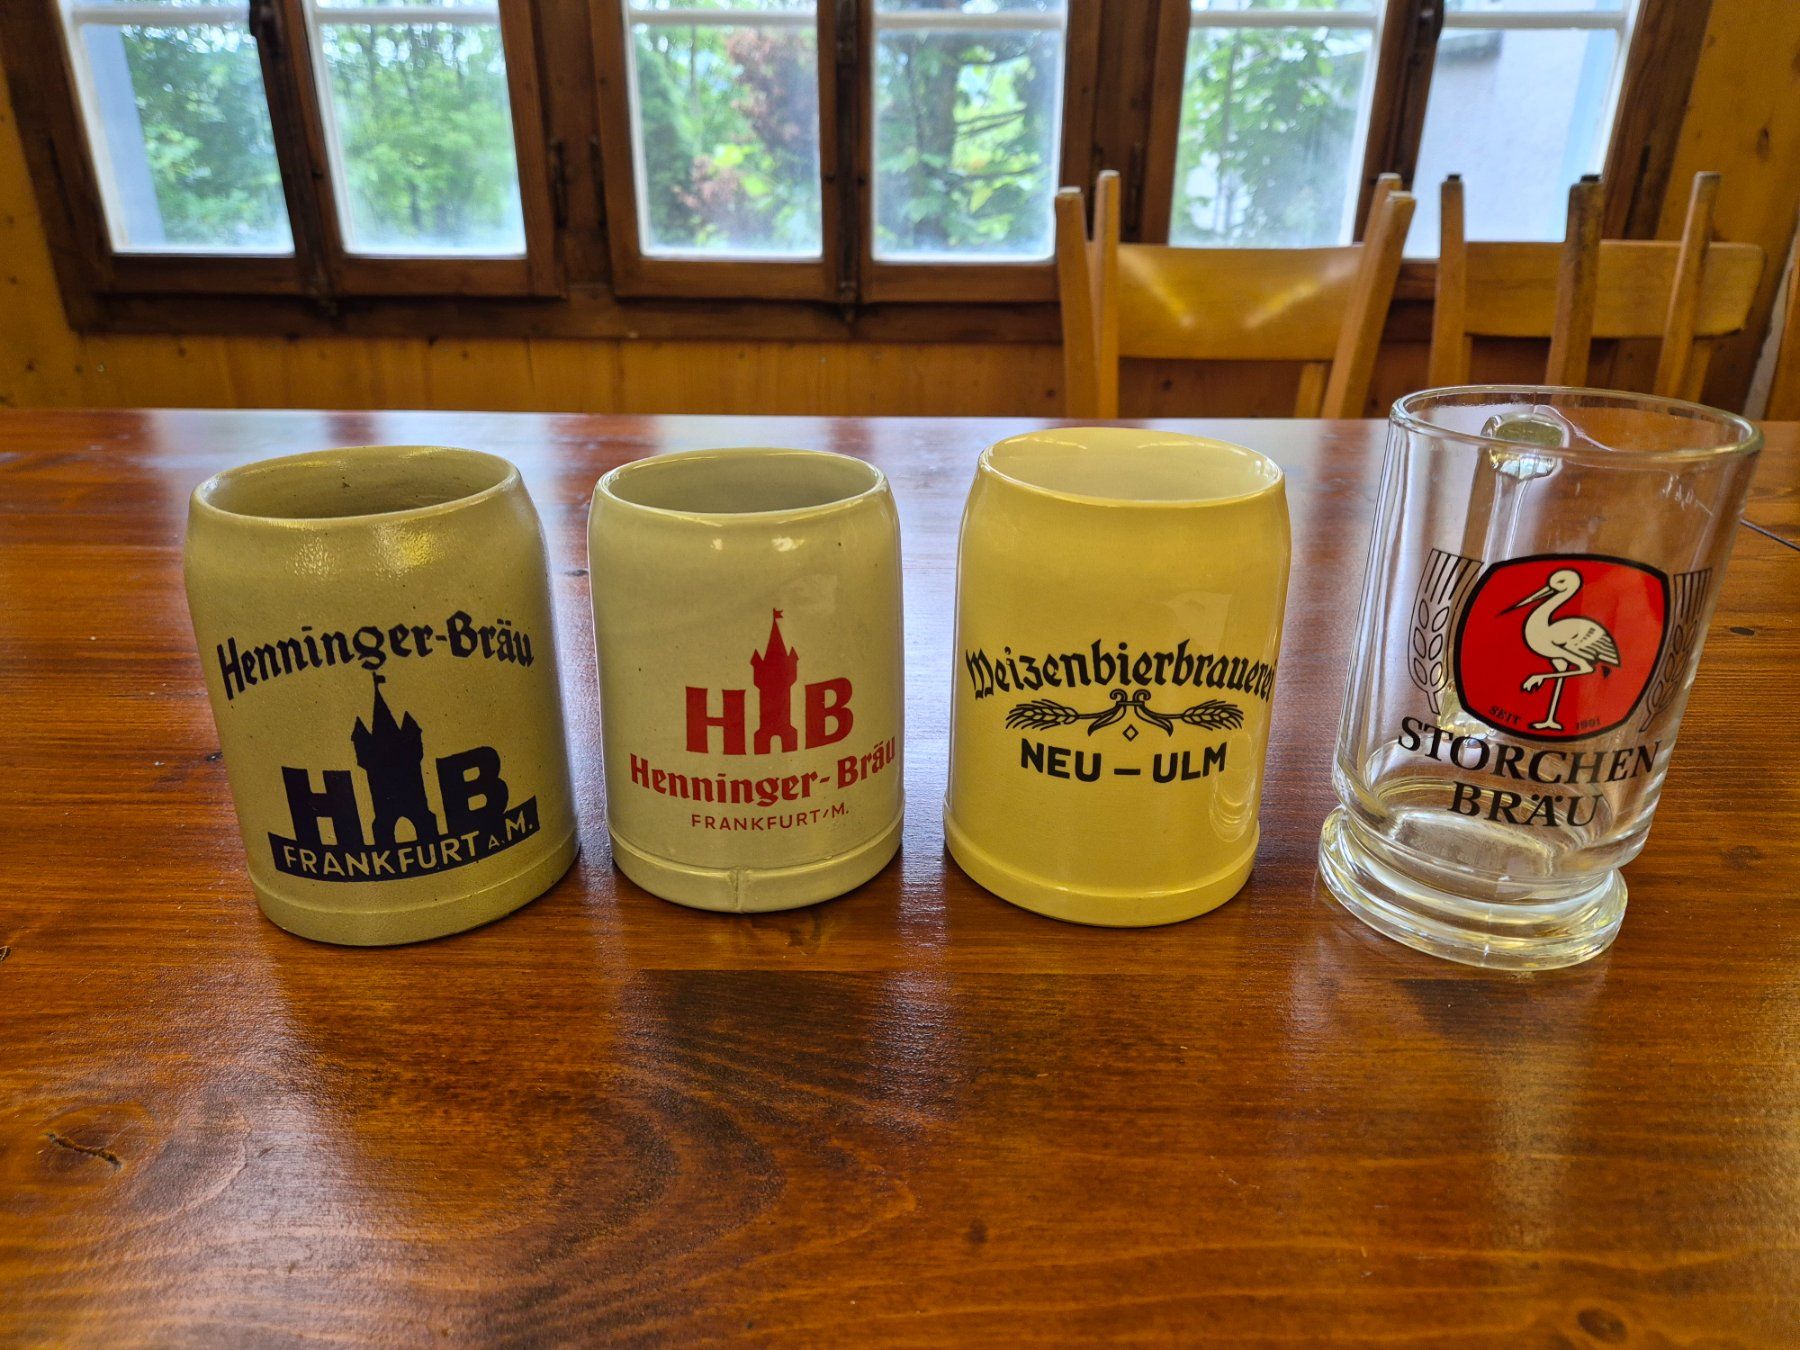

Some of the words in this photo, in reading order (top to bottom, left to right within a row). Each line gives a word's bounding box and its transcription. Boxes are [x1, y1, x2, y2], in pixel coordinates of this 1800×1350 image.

[1398, 716, 1662, 784] STORCHEN
[1446, 780, 1604, 828] BRÄU
[283, 830, 480, 879] FRANKFURT
